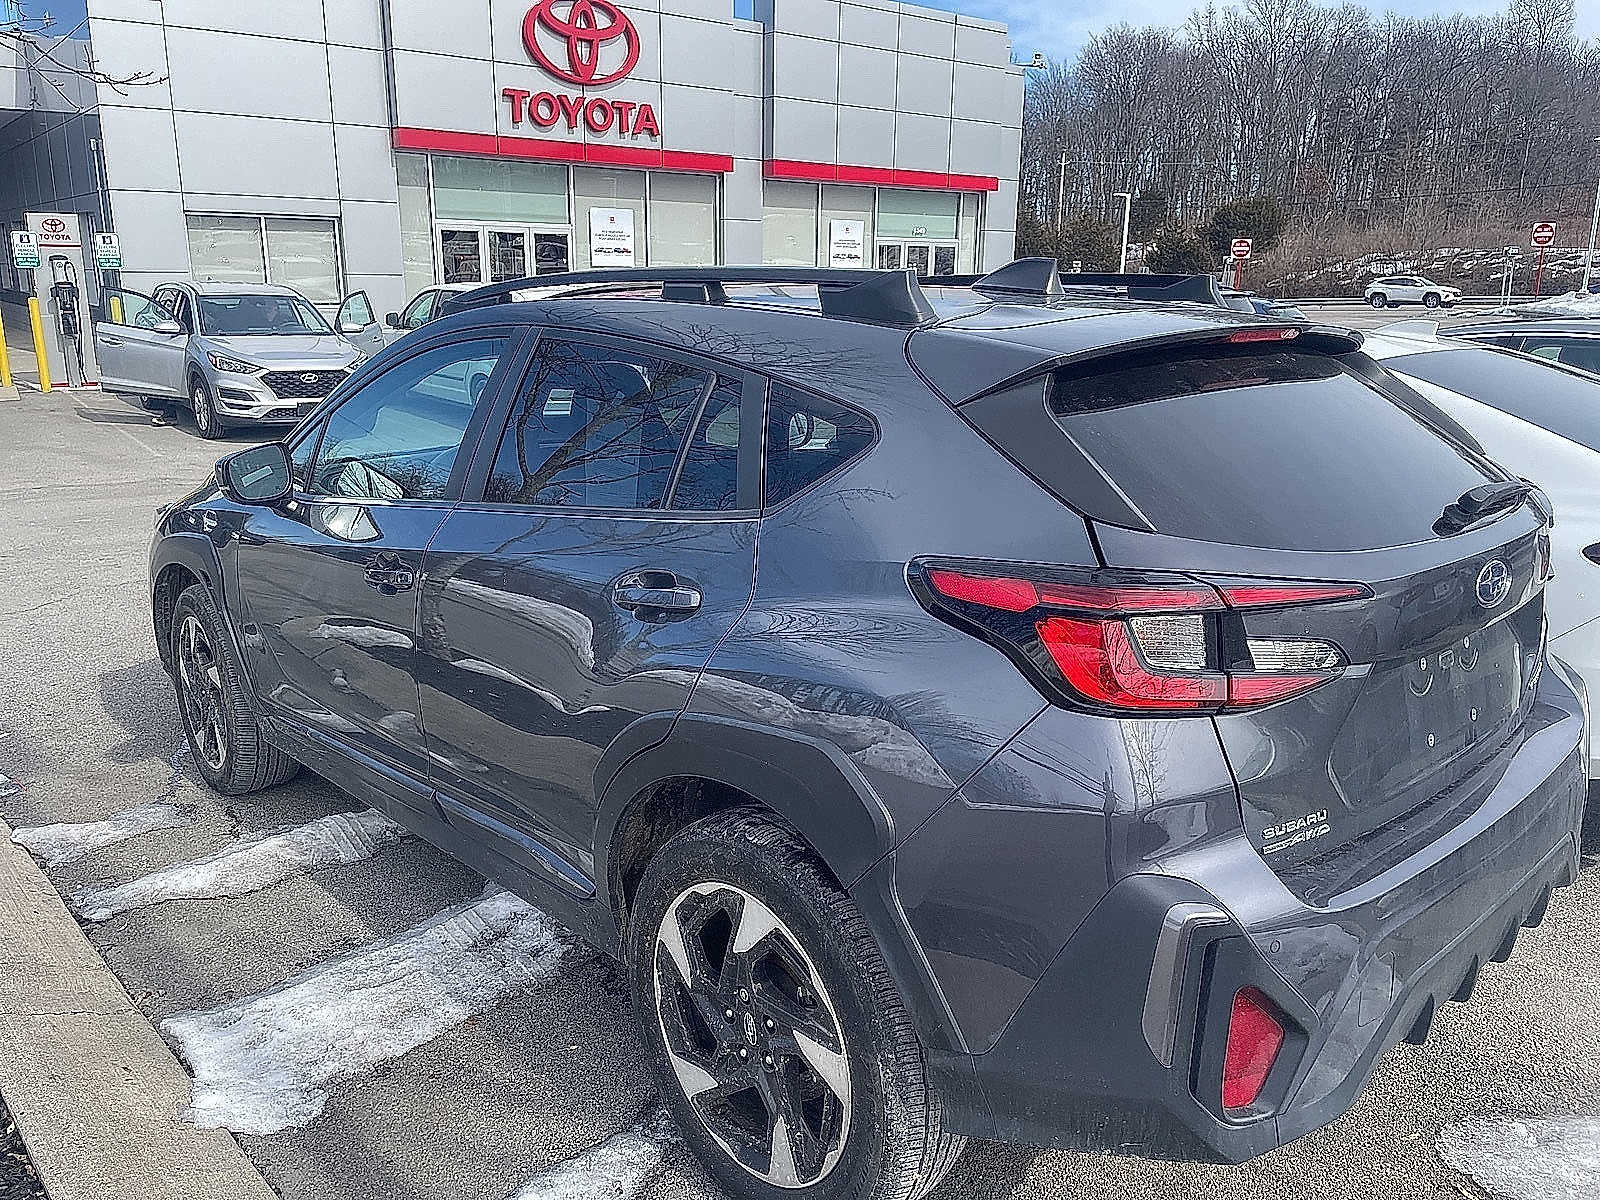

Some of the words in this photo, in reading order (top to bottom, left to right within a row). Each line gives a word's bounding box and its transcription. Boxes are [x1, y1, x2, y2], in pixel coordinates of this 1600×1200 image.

[502, 88, 660, 138] TOYOTA
[39, 233, 72, 241] TOYOTA
[1262, 809, 1328, 839] SUBARU
